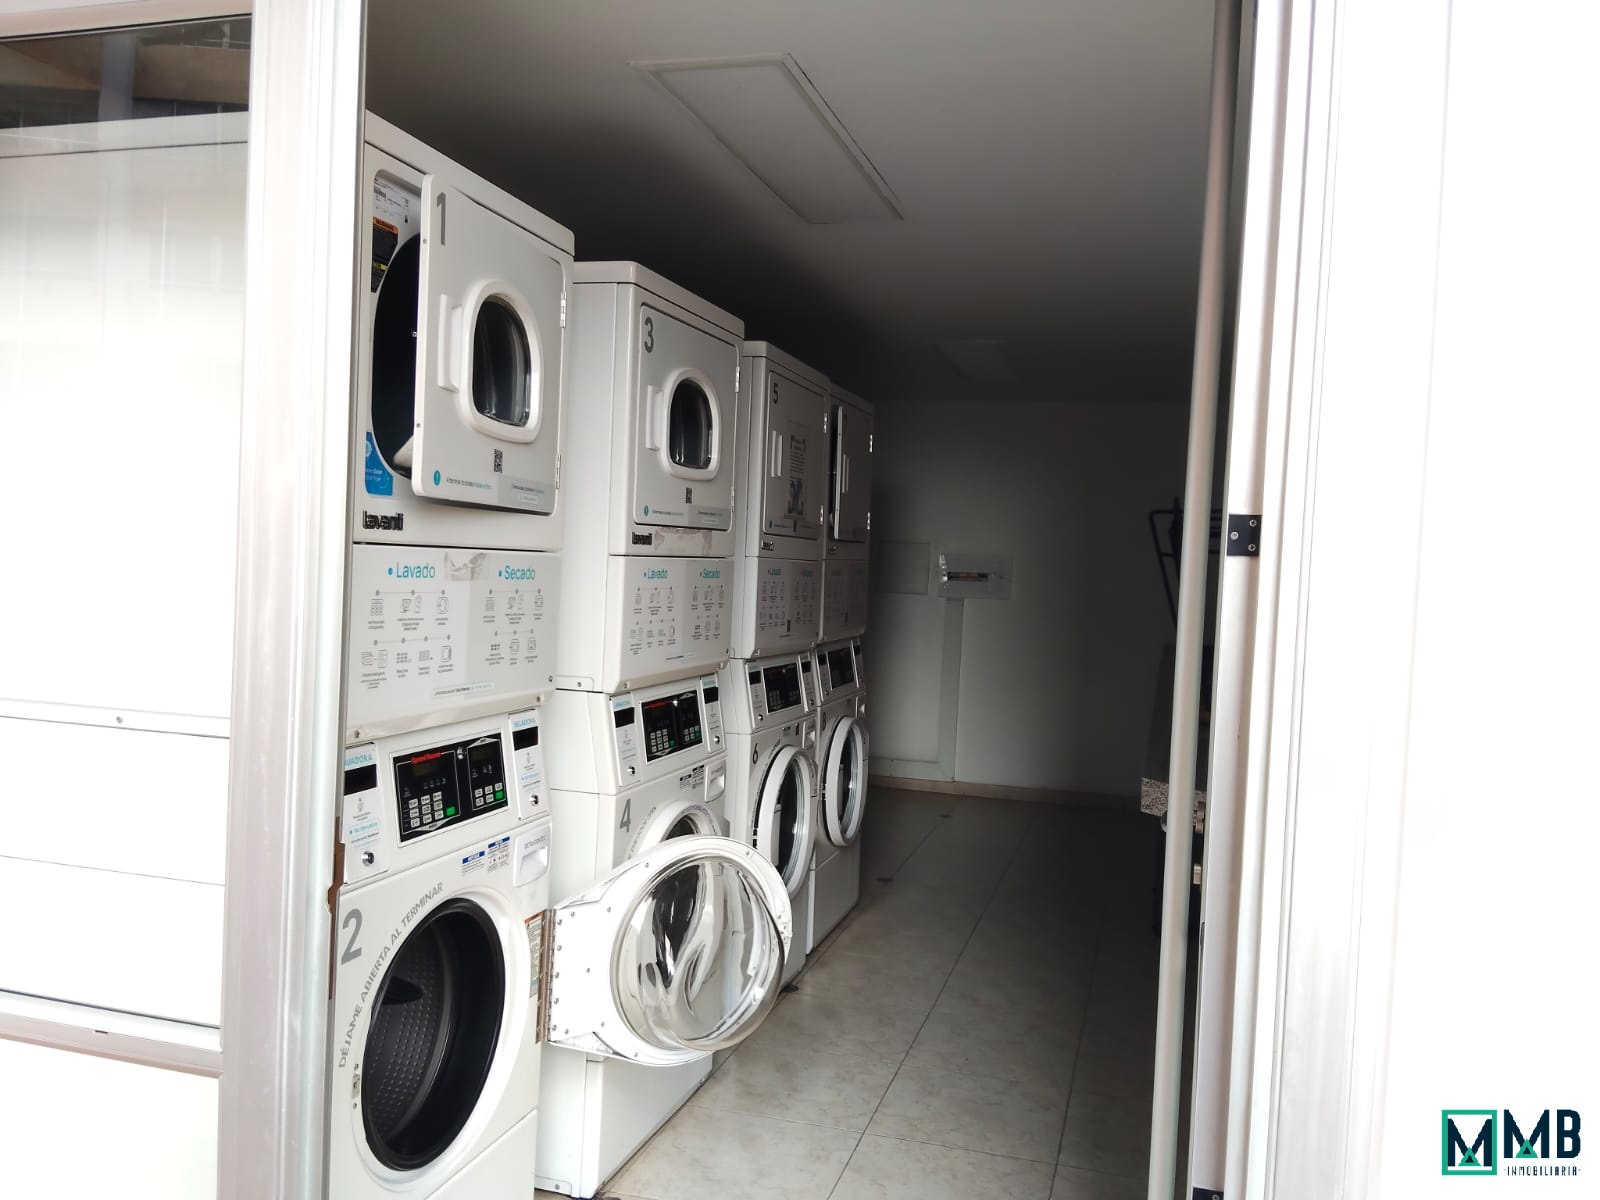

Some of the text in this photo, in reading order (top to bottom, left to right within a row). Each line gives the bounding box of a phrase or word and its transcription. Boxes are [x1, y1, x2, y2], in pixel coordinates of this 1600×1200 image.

[436, 192, 447, 246] 1
[644, 316, 654, 353] 3
[773, 383, 779, 404] 5
[396, 562, 436, 579] Lavado
[504, 565, 536, 581] Secado
[647, 568, 668, 580] Lavado
[702, 568, 720, 579] Secado
[752, 743, 759, 765] 6
[619, 798, 632, 833] 4
[341, 908, 363, 966] 2
[337, 882, 443, 1068] DÉJAME ABIERTA AL TERMINAR
